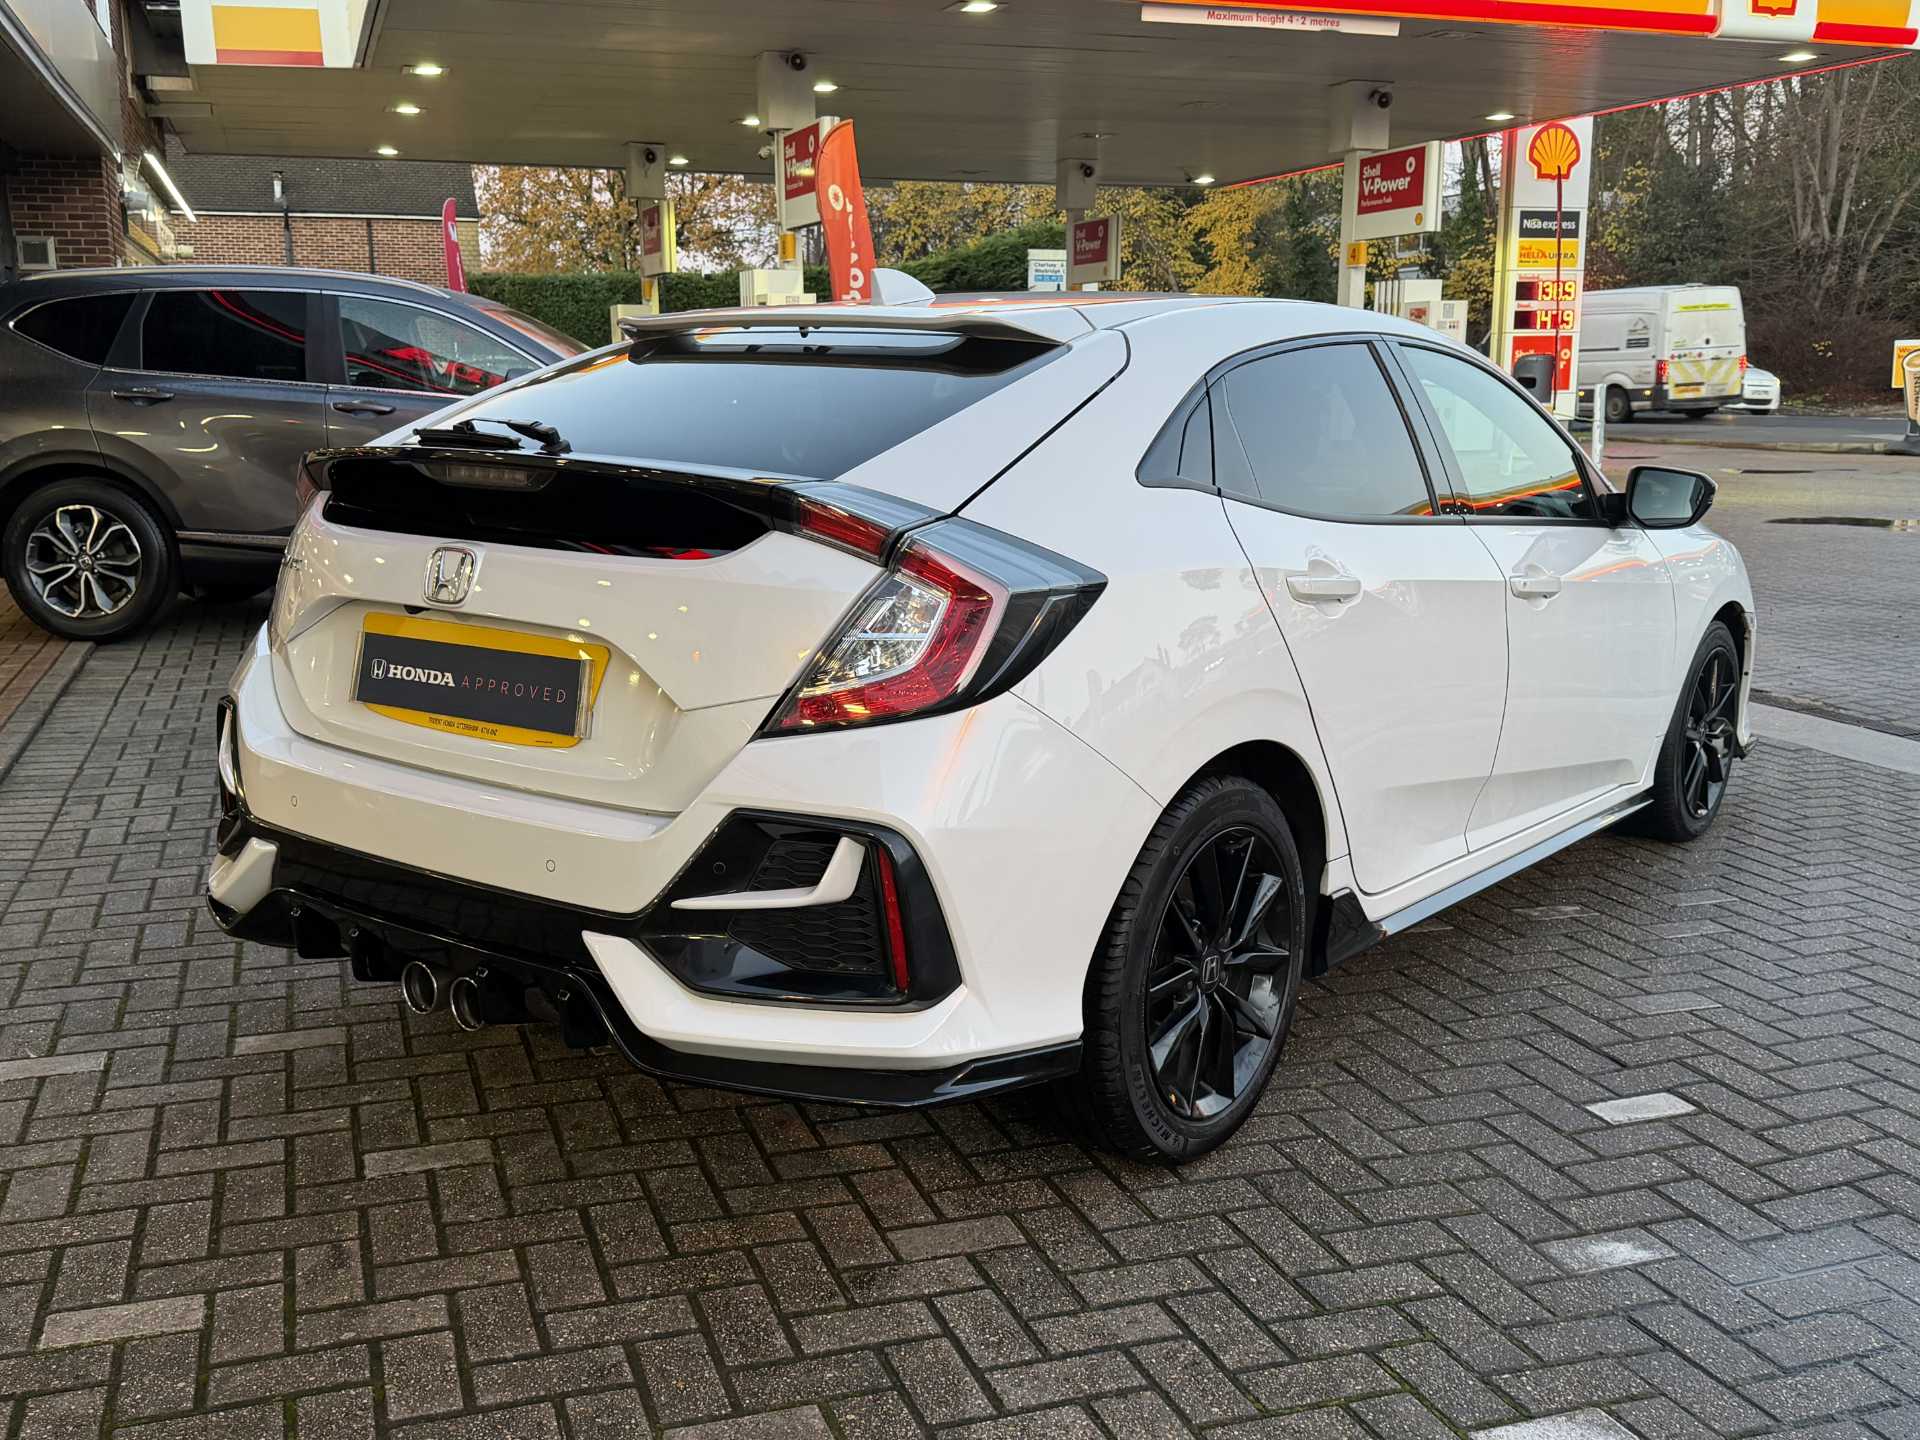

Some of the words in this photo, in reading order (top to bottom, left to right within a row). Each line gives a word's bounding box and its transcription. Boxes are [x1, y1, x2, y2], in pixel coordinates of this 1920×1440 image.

[1207, 10, 1254, 23] Maximum
[1256, 13, 1286, 26] height
[1310, 18, 1341, 28] metres
[1362, 162, 1381, 178] Shell
[1362, 176, 1411, 196] V-Power
[1543, 220, 1576, 231] expess
[1350, 247, 1357, 263] 4
[387, 663, 456, 688] HONDA
[461, 675, 567, 704] APPROVED
[1132, 1068, 1173, 1142] MICHELIN
